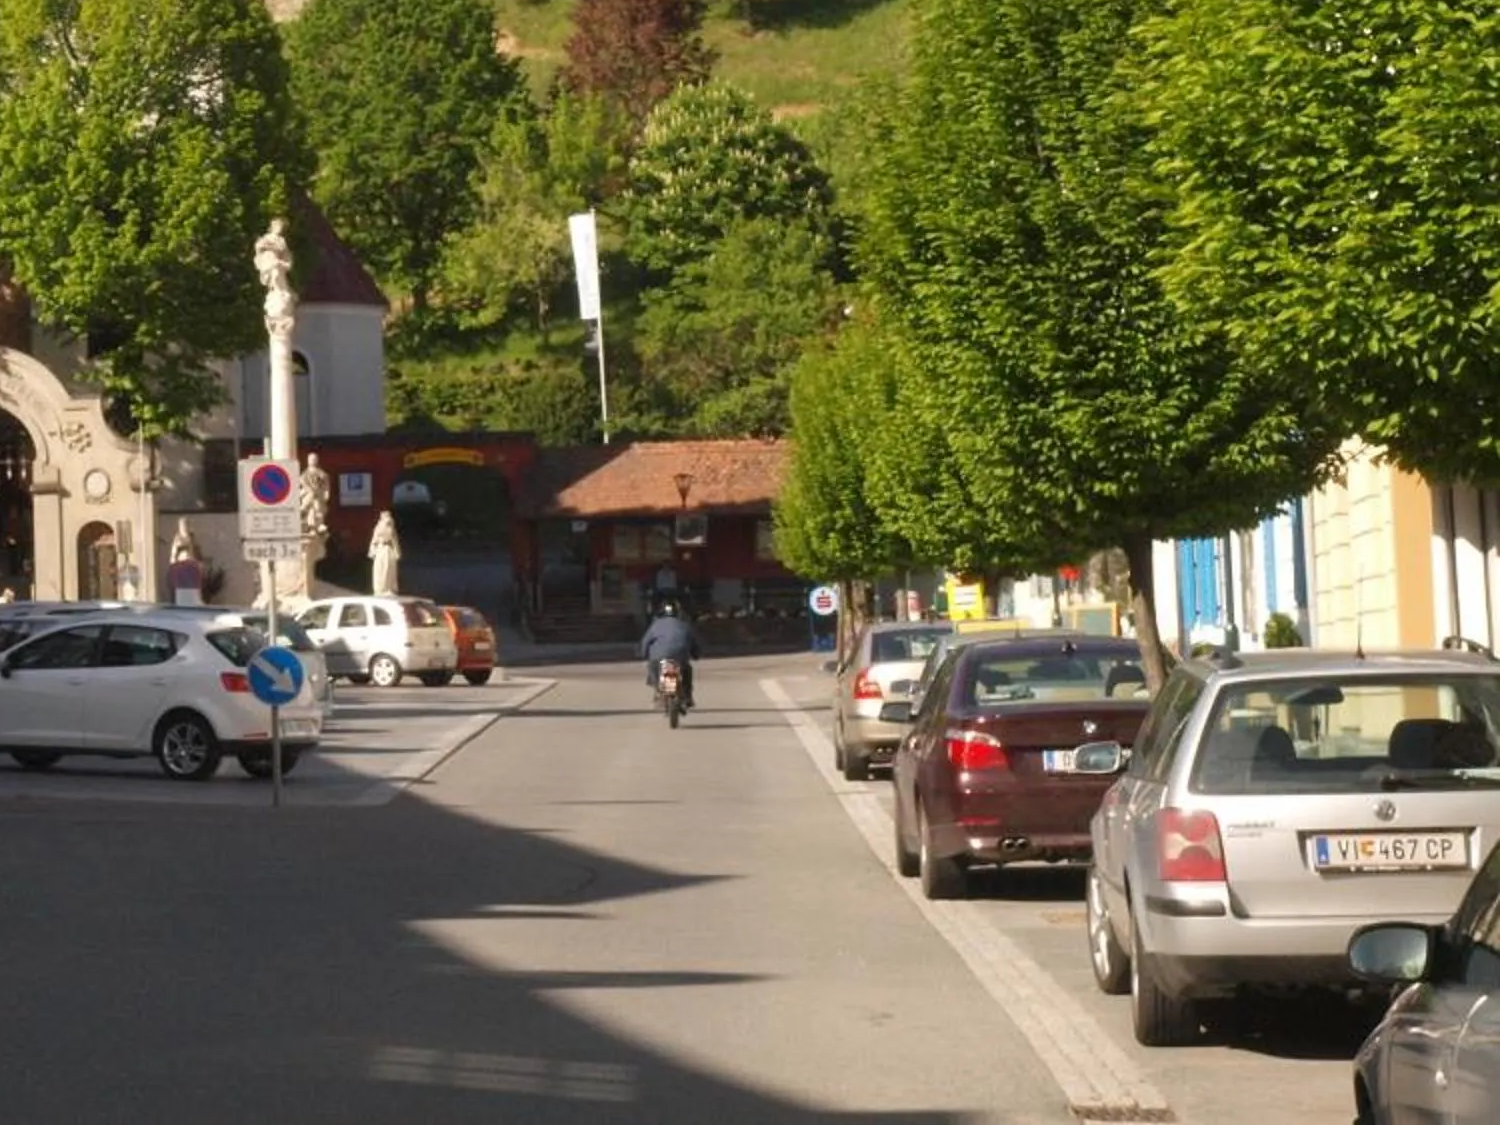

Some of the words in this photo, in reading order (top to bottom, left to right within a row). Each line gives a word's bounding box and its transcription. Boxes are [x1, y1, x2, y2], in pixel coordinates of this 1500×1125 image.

[1337, 839, 1358, 860] VI
[1379, 838, 1419, 860] 467
[1425, 838, 1453, 860] CP
